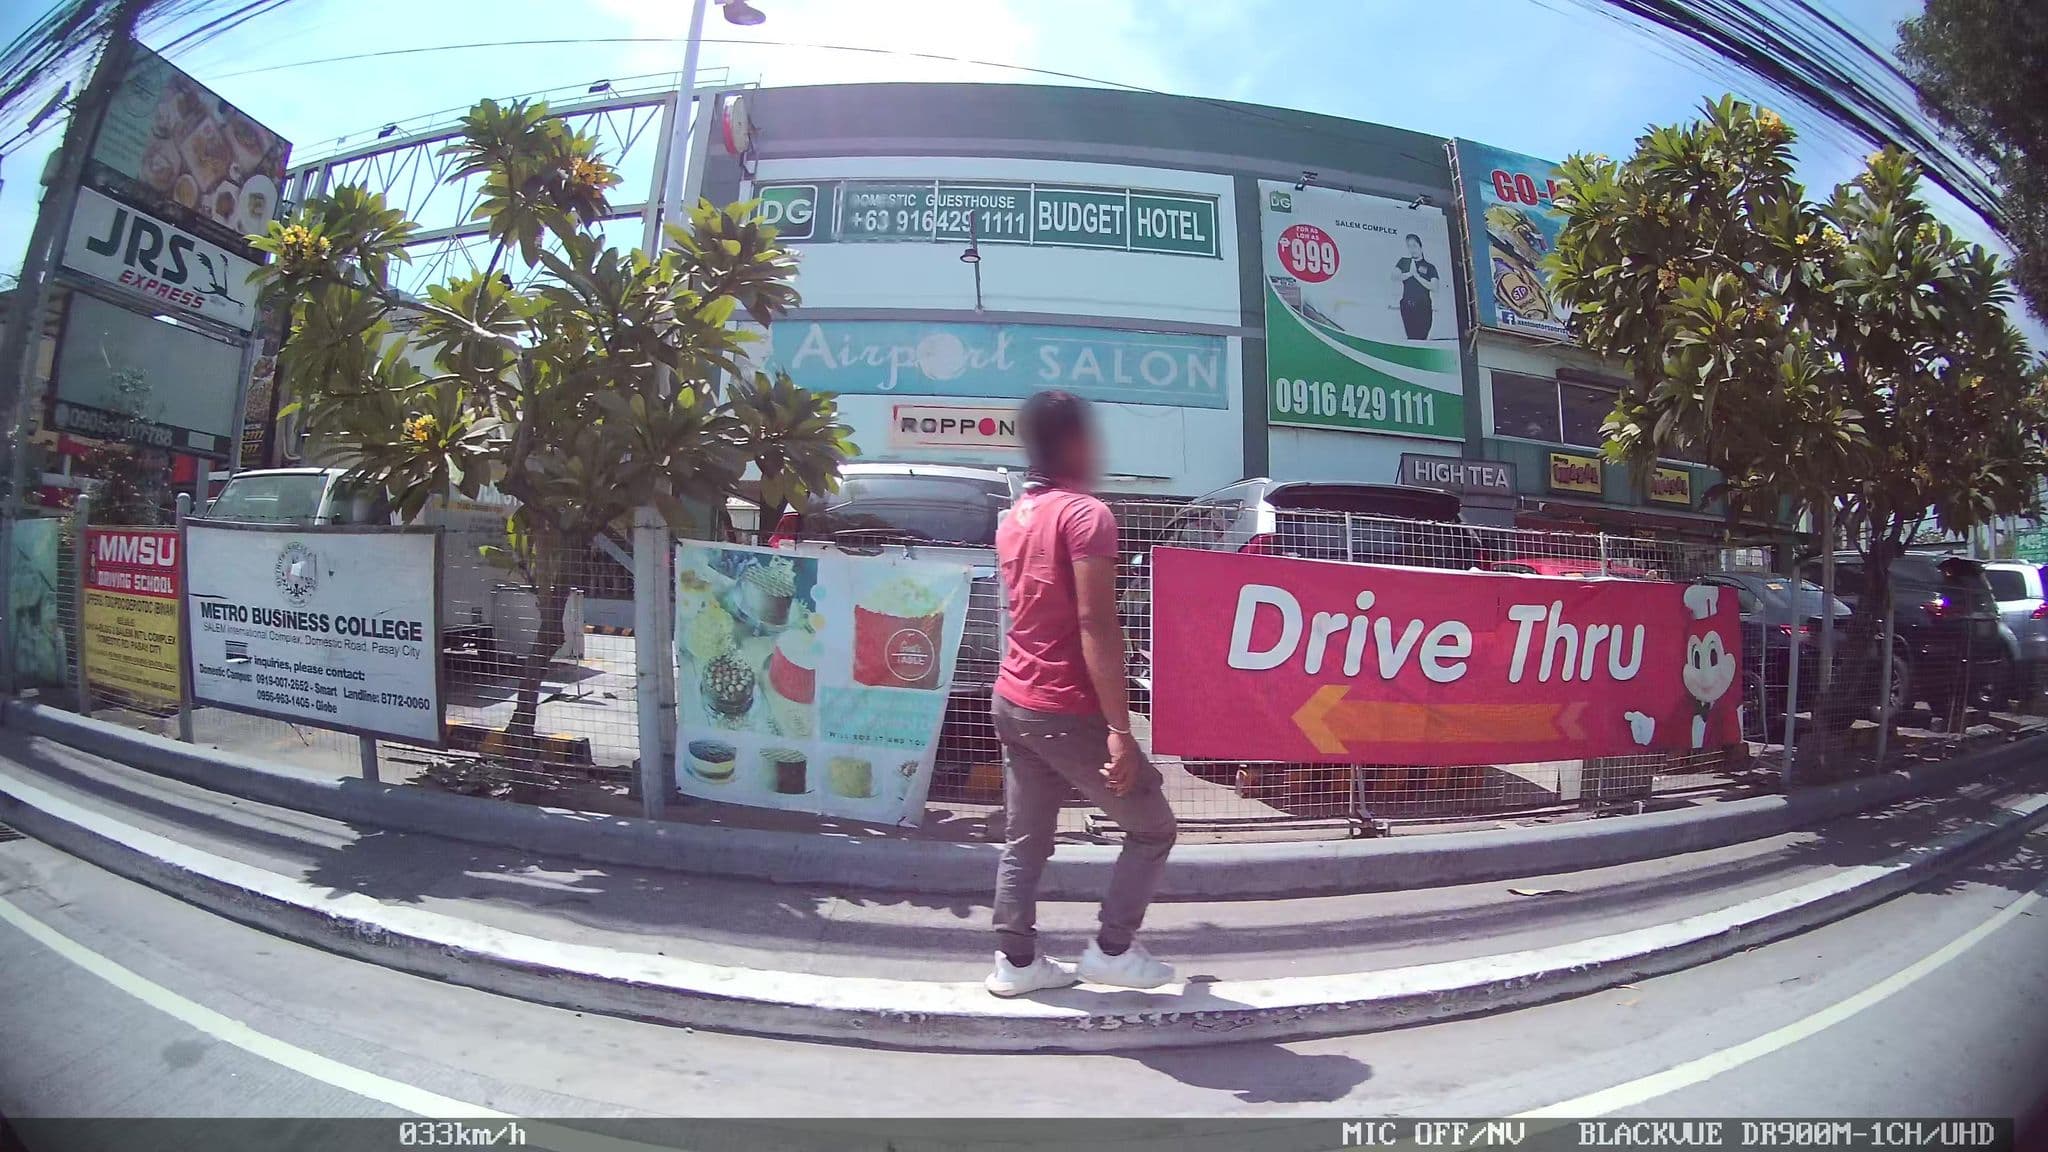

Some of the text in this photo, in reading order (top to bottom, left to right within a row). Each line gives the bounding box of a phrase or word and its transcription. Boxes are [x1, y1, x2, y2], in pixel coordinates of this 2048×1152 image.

[762, 199, 814, 225] DG
[925, 193, 1016, 209] GUESTHOUSE
[1271, 195, 1291, 209] DG
[896, 210, 933, 232] 916
[937, 210, 972, 233] 429
[981, 211, 1025, 234] 1111
[1038, 201, 1206, 242] BUDGET HOTEL
[1296, 225, 1309, 233] FOR
[1335, 219, 1398, 235] SALEM COMPLEX
[86, 207, 195, 285] JRS
[119, 269, 206, 309] EXPRESS
[792, 323, 1218, 390] Airport SALON
[1276, 378, 1435, 426] 0916 429 1111
[1414, 460, 1510, 488] HIGH TEA
[99, 535, 176, 567] MMSU
[134, 574, 174, 594] SCHOOL
[200, 601, 248, 623] METRO
[252, 607, 330, 633] BUSINESS
[334, 615, 423, 642] COLLEGE
[1227, 583, 1646, 683] Drive Thru
[203, 622, 226, 634] SALEM
[371, 641, 400, 658] Pasay
[402, 645, 421, 660] City
[254, 654, 292, 672] inquiries,
[294, 661, 324, 674] please
[325, 667, 366, 681] contact:
[314, 683, 338, 697] Smart
[381, 692, 431, 711] 8772-0060
[315, 700, 338, 714] Globe
